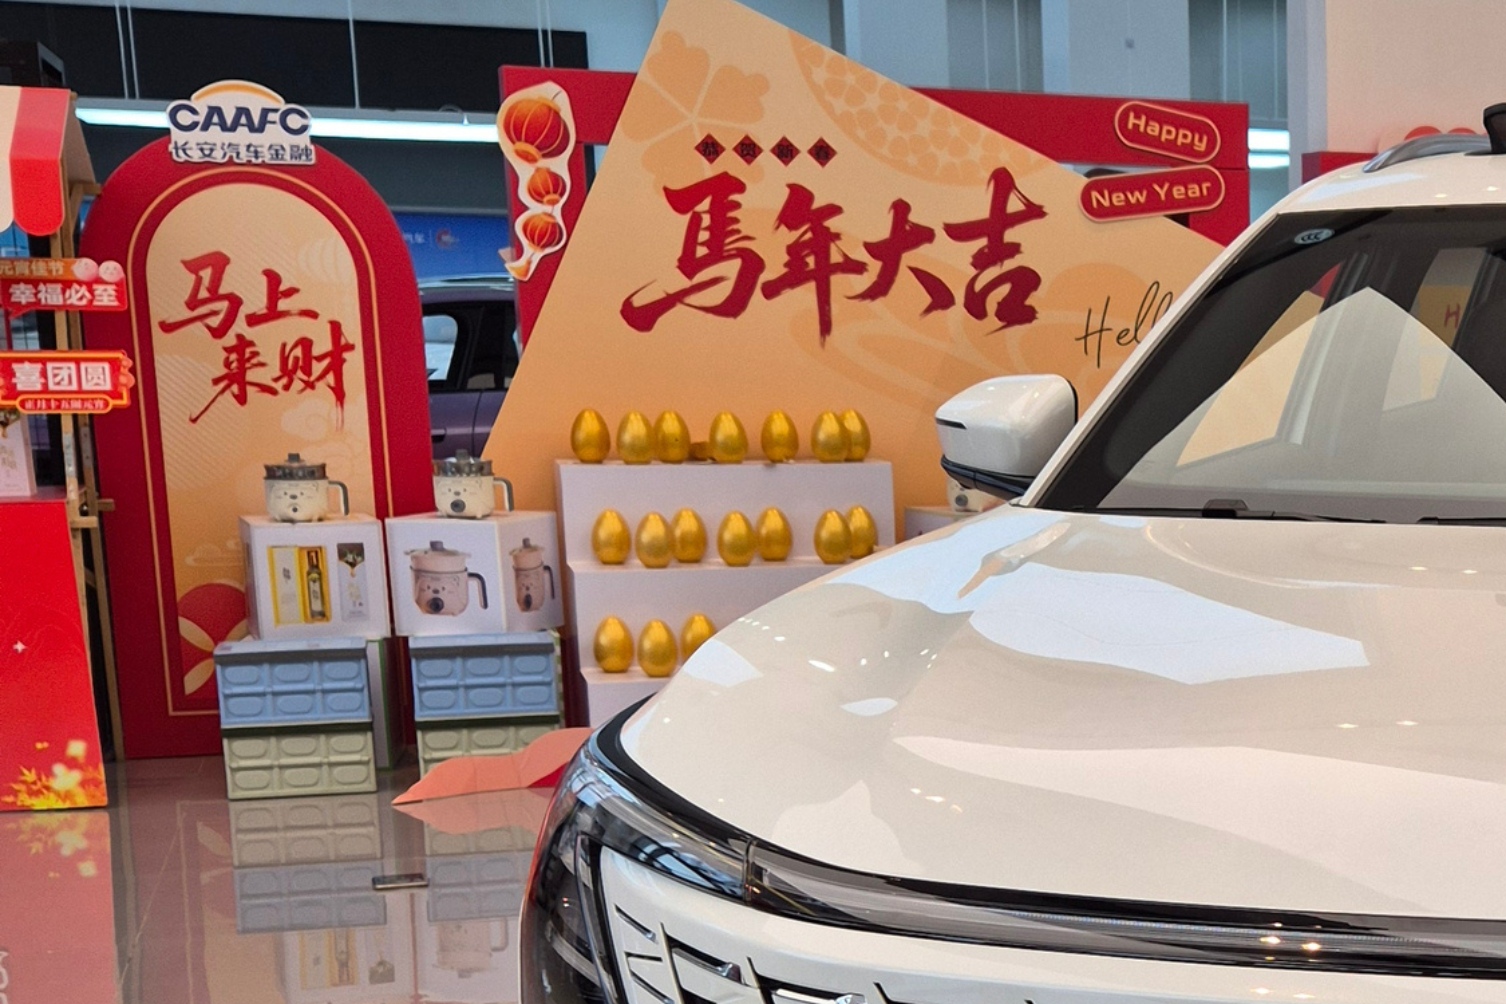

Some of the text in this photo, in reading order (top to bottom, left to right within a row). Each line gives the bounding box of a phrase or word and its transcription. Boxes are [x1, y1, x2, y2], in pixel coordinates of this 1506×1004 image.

[168, 103, 309, 136] CAAFC
[1127, 111, 1207, 151] Happy
[173, 140, 313, 162] 长安汽车金融
[1090, 180, 1211, 208] New Year
[620, 167, 1048, 349] 馬年大吉
[9, 282, 119, 306] 幸福必至
[158, 251, 319, 339] 马上
[12, 361, 113, 391] 喜团圆
[189, 320, 356, 424] 来财
